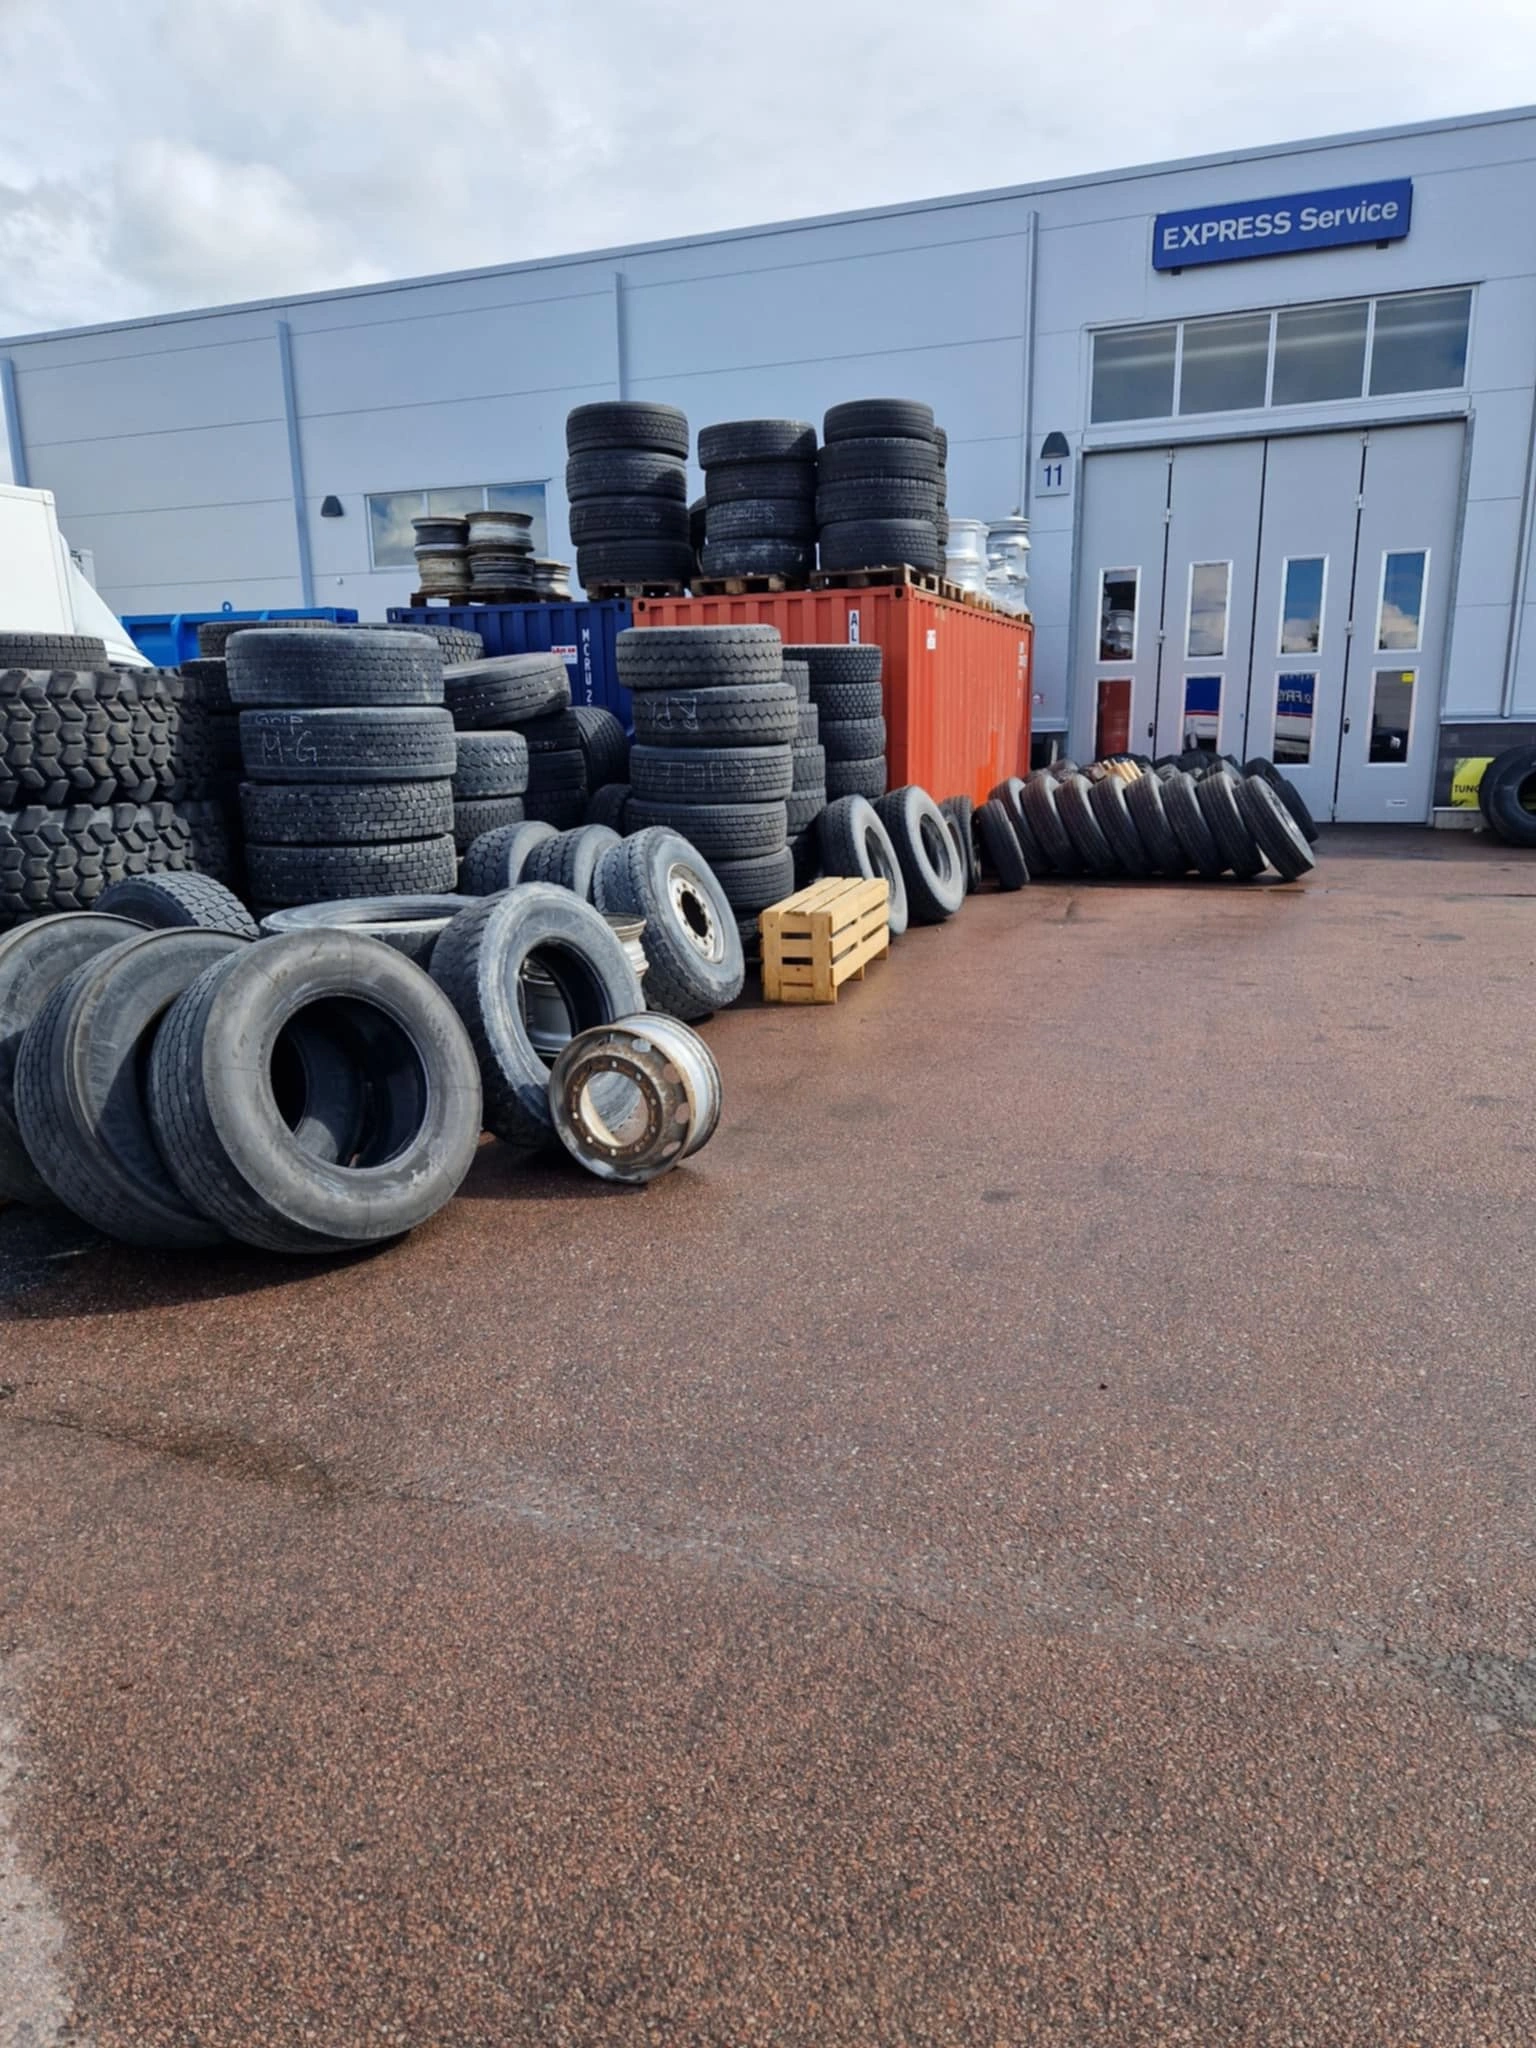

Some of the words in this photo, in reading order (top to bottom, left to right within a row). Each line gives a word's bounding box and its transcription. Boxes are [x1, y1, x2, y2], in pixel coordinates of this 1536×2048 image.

[1163, 211, 1292, 251] EXPRESS
[1299, 200, 1399, 232] Service
[1043, 463, 1063, 488] 11
